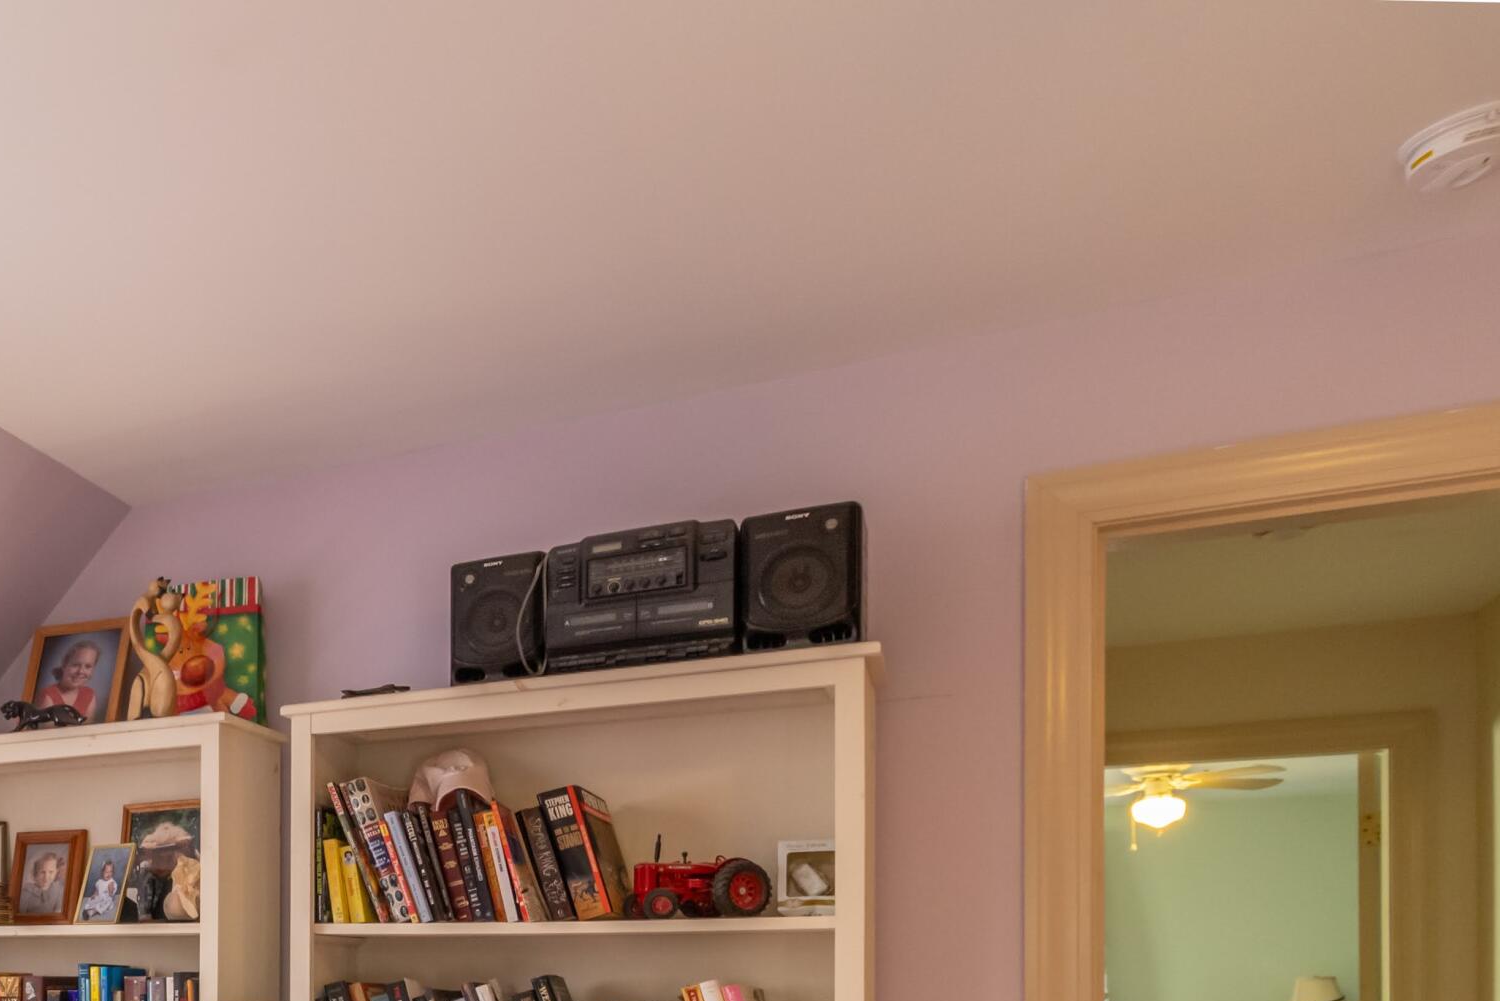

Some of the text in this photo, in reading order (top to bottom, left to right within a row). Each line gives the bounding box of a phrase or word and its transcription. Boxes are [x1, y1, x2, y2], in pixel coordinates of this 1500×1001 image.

[784, 511, 810, 521] SONY
[483, 559, 504, 569] SONY
[544, 794, 571, 809] STEPHEN
[547, 802, 574, 822] KING
[539, 850, 558, 877] KING
